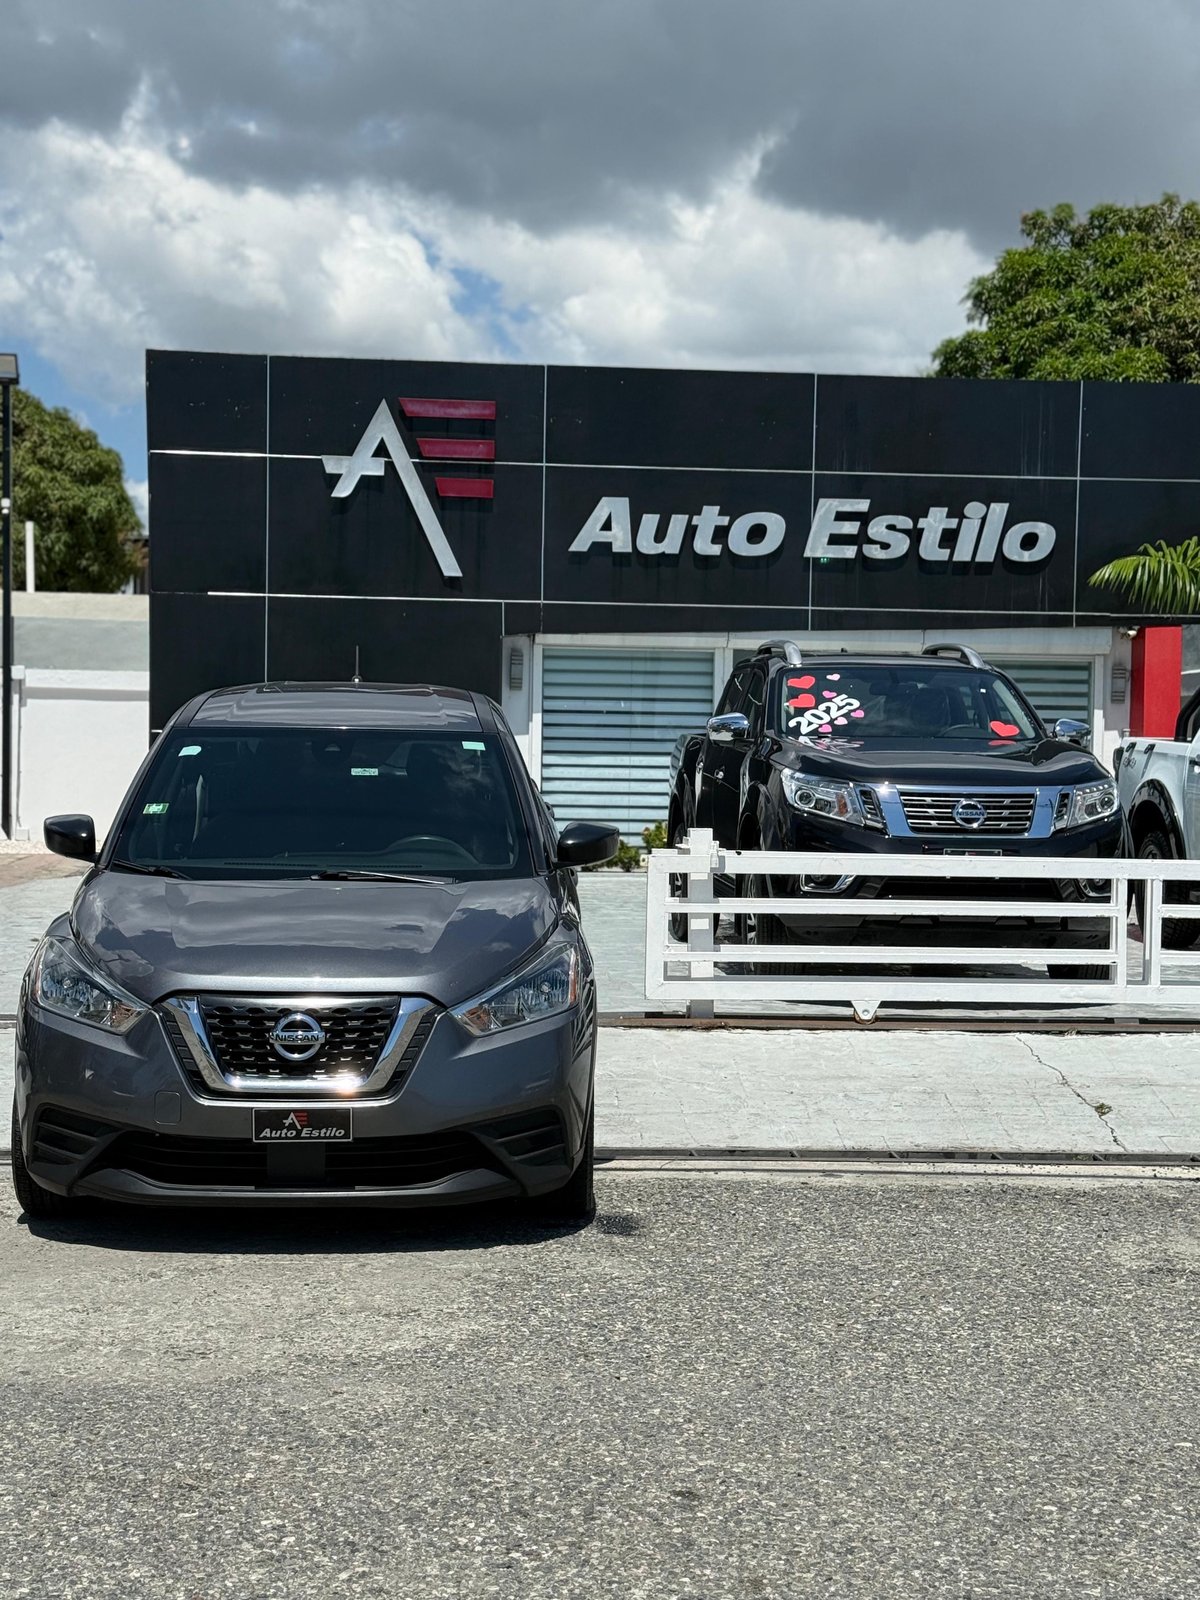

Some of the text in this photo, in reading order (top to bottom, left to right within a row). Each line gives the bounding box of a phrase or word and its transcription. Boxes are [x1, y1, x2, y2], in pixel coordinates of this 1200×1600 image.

[568, 496, 1057, 562] Auto Estilo
[788, 693, 860, 735] 2025
[275, 1033, 319, 1042] NISSAN
[259, 1127, 346, 1138] Auto Estilo
